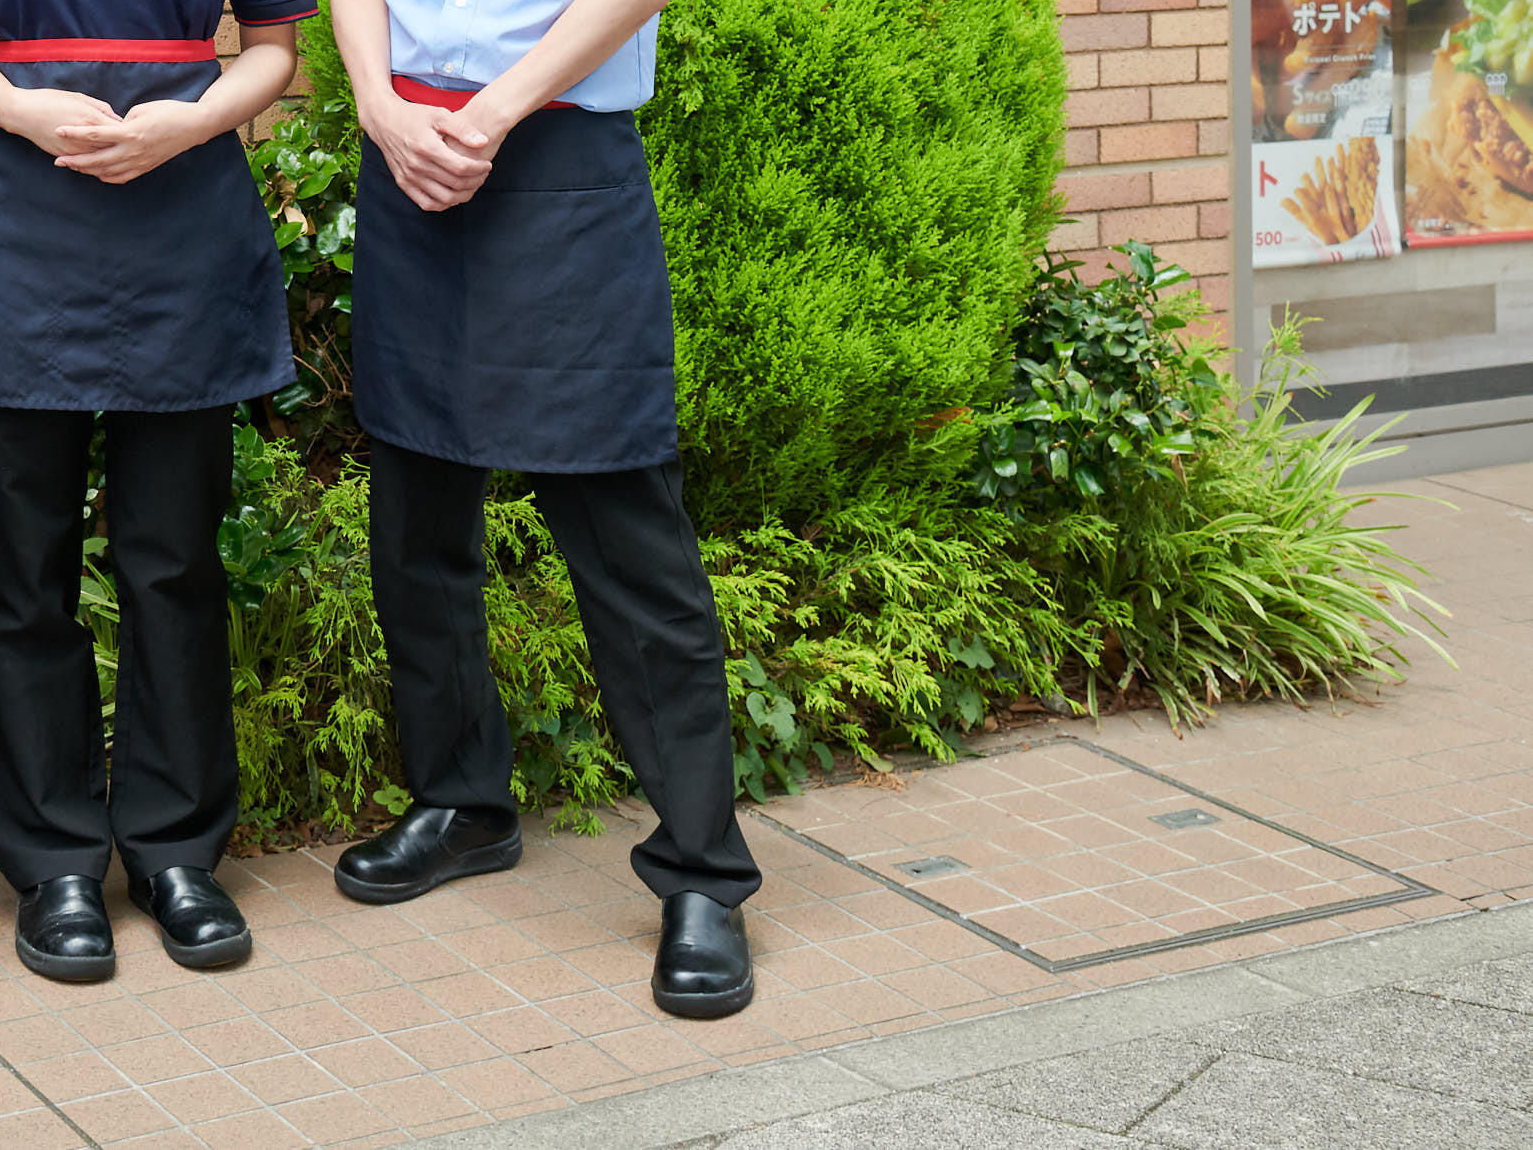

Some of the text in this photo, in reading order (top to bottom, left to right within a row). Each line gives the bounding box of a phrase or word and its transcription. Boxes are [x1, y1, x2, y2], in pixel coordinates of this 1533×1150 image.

[1292, 1, 1361, 37] ポテト
[1255, 231, 1283, 246] 500
